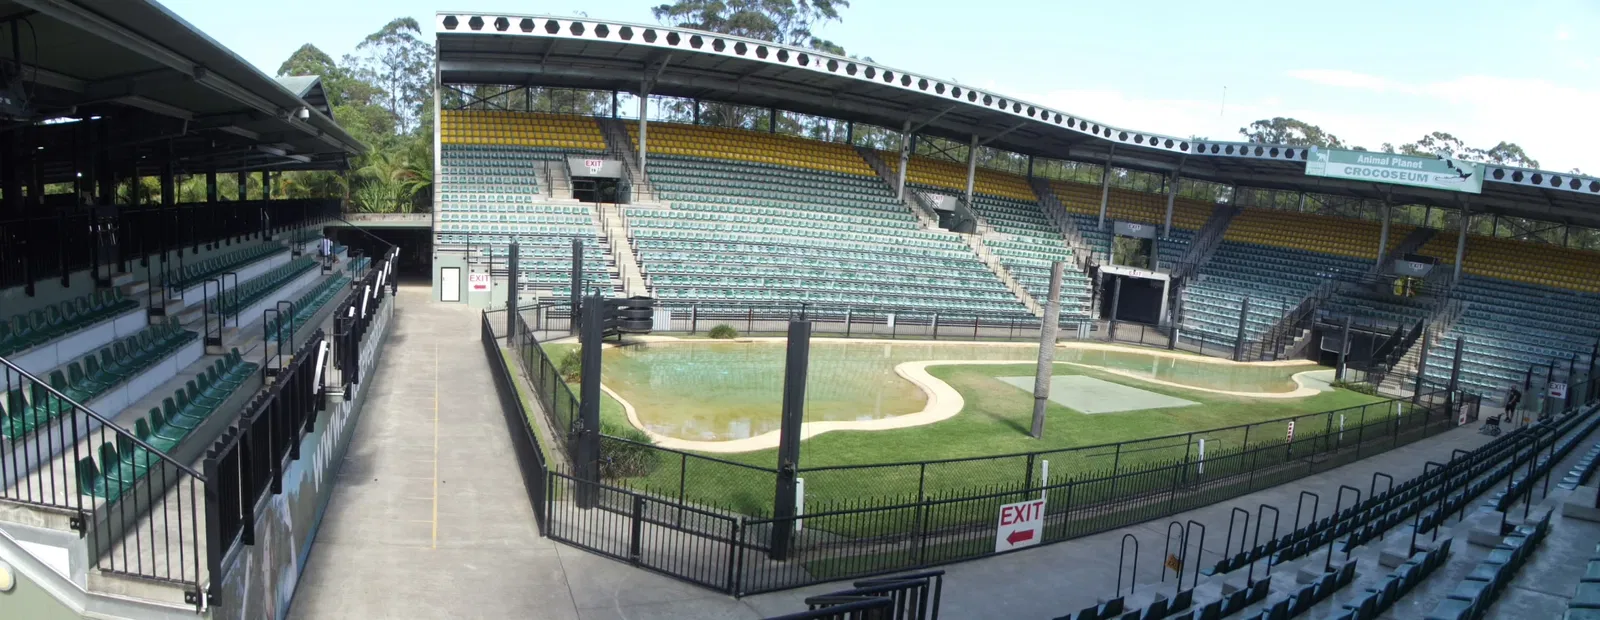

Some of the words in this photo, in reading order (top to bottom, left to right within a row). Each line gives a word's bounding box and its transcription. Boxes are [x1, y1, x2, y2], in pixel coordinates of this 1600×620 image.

[1357, 154, 1389, 166] Animal
[1391, 156, 1423, 169] Planet
[1344, 166, 1429, 183] CROCOSEUM
[1549, 382, 1566, 390] EXIT
[1000, 501, 1044, 526] EXIT
